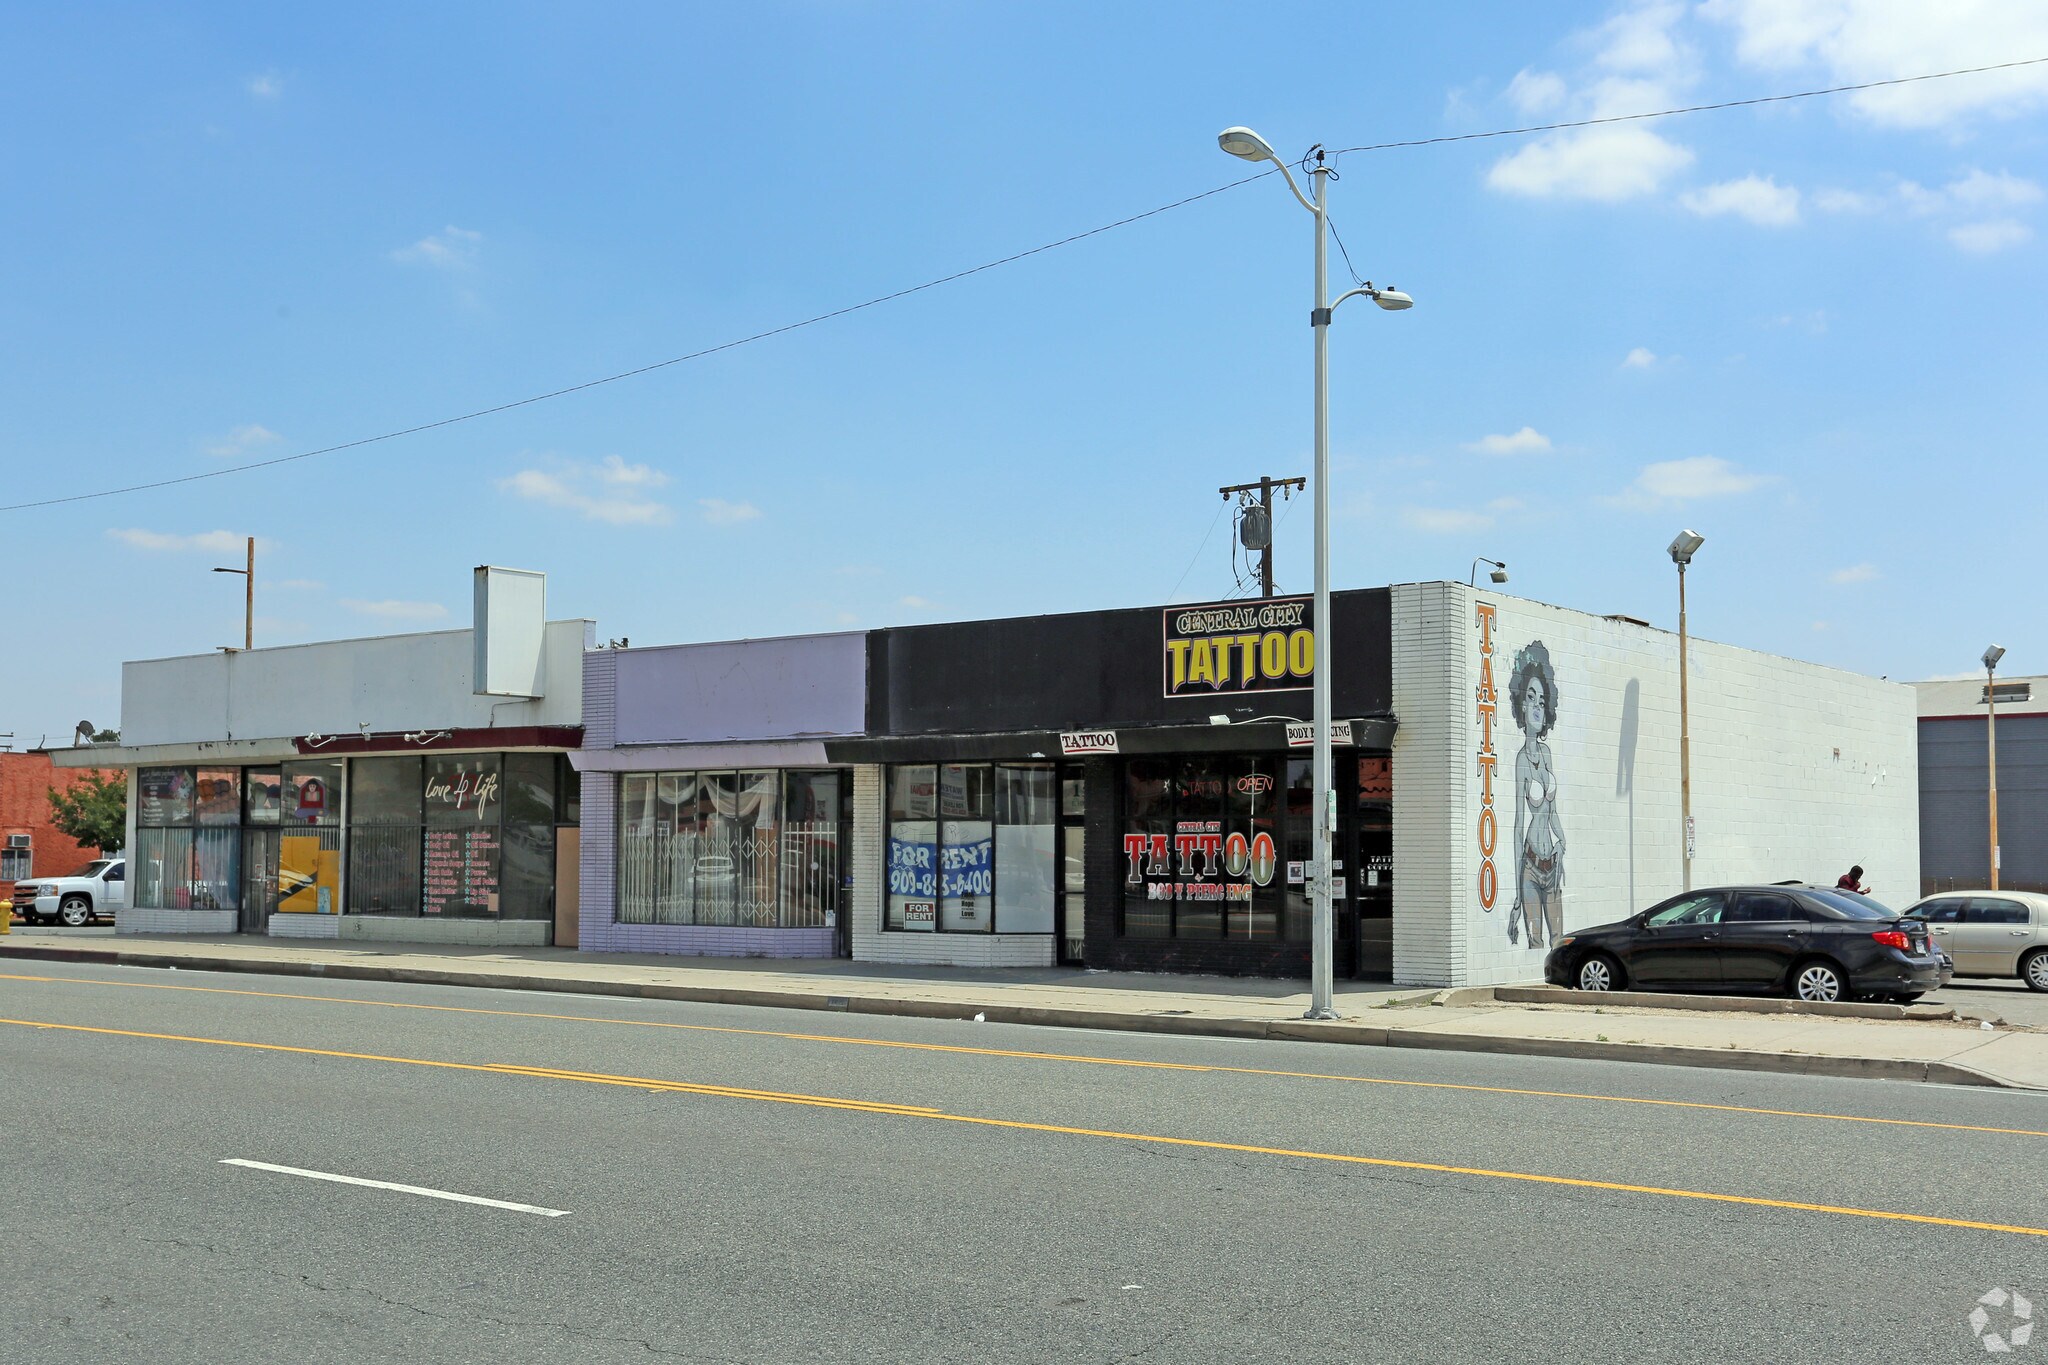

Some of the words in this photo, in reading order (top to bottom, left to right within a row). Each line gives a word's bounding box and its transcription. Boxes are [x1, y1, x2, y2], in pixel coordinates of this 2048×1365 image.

[1177, 607, 1258, 635] CENTRAL
[1259, 603, 1305, 627] CITY
[1167, 628, 1314, 693] TATTOO
[1288, 727, 1308, 739] BODY
[1062, 734, 1115, 748] TATTOO
[1475, 600, 1498, 913] TATTOO
[1188, 780, 1232, 795] TATTO
[1237, 778, 1273, 791] OPEN
[425, 777, 452, 802] Love
[474, 773, 498, 820] Life
[1177, 821, 1205, 832] CENTRAL
[1205, 821, 1221, 832] CITY
[892, 842, 930, 869] FOR
[941, 841, 991, 869] RENT
[1124, 832, 1276, 886] TATTOO
[1370, 855, 1392, 863] TATT
[1148, 882, 1183, 900] BODY
[1187, 883, 1252, 901] PIERCING
[909, 904, 929, 912] FOR
[906, 912, 932, 920] RENT
